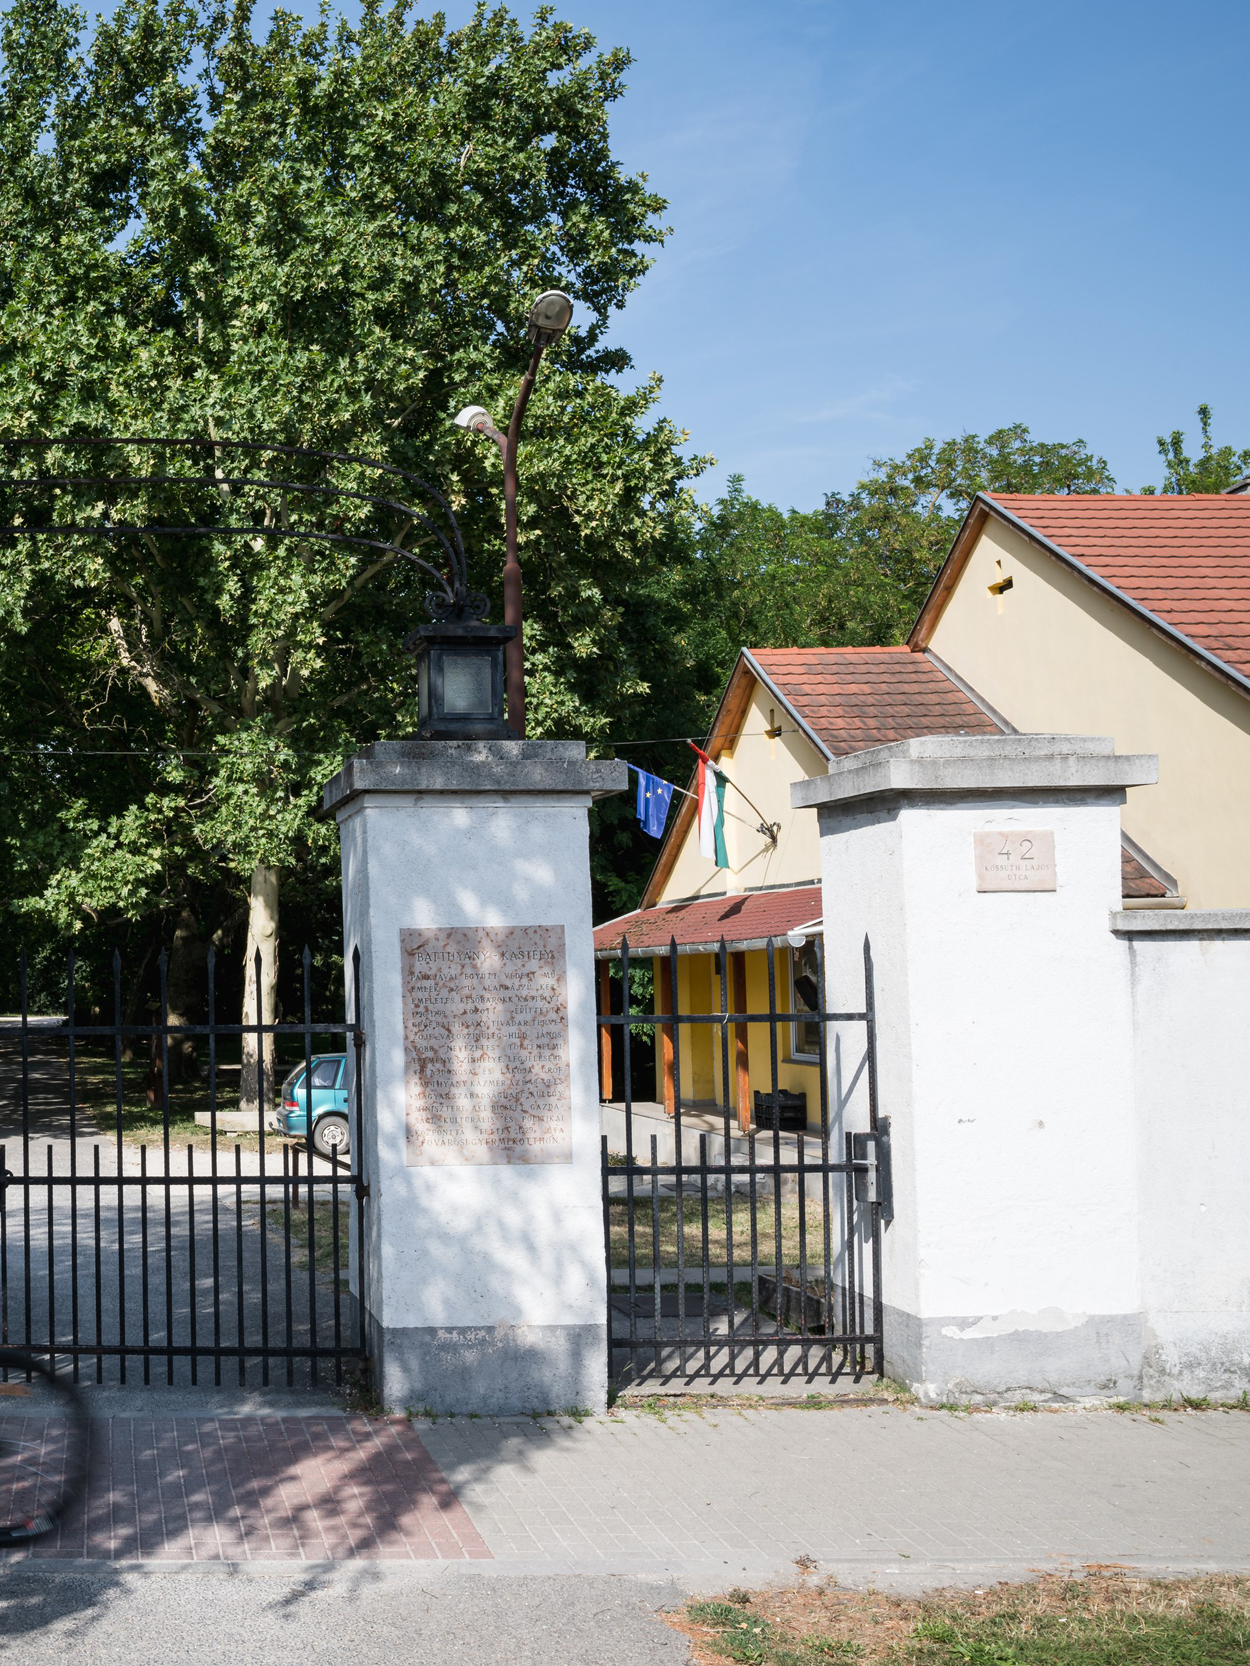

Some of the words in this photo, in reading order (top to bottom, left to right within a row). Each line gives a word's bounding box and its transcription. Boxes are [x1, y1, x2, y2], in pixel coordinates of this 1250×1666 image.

[997, 839, 1035, 861] 42
[984, 864, 1020, 872] KOSSUTH
[417, 949, 489, 962] BATTHYÁNY
[502, 948, 551, 961] KASTÉLY
